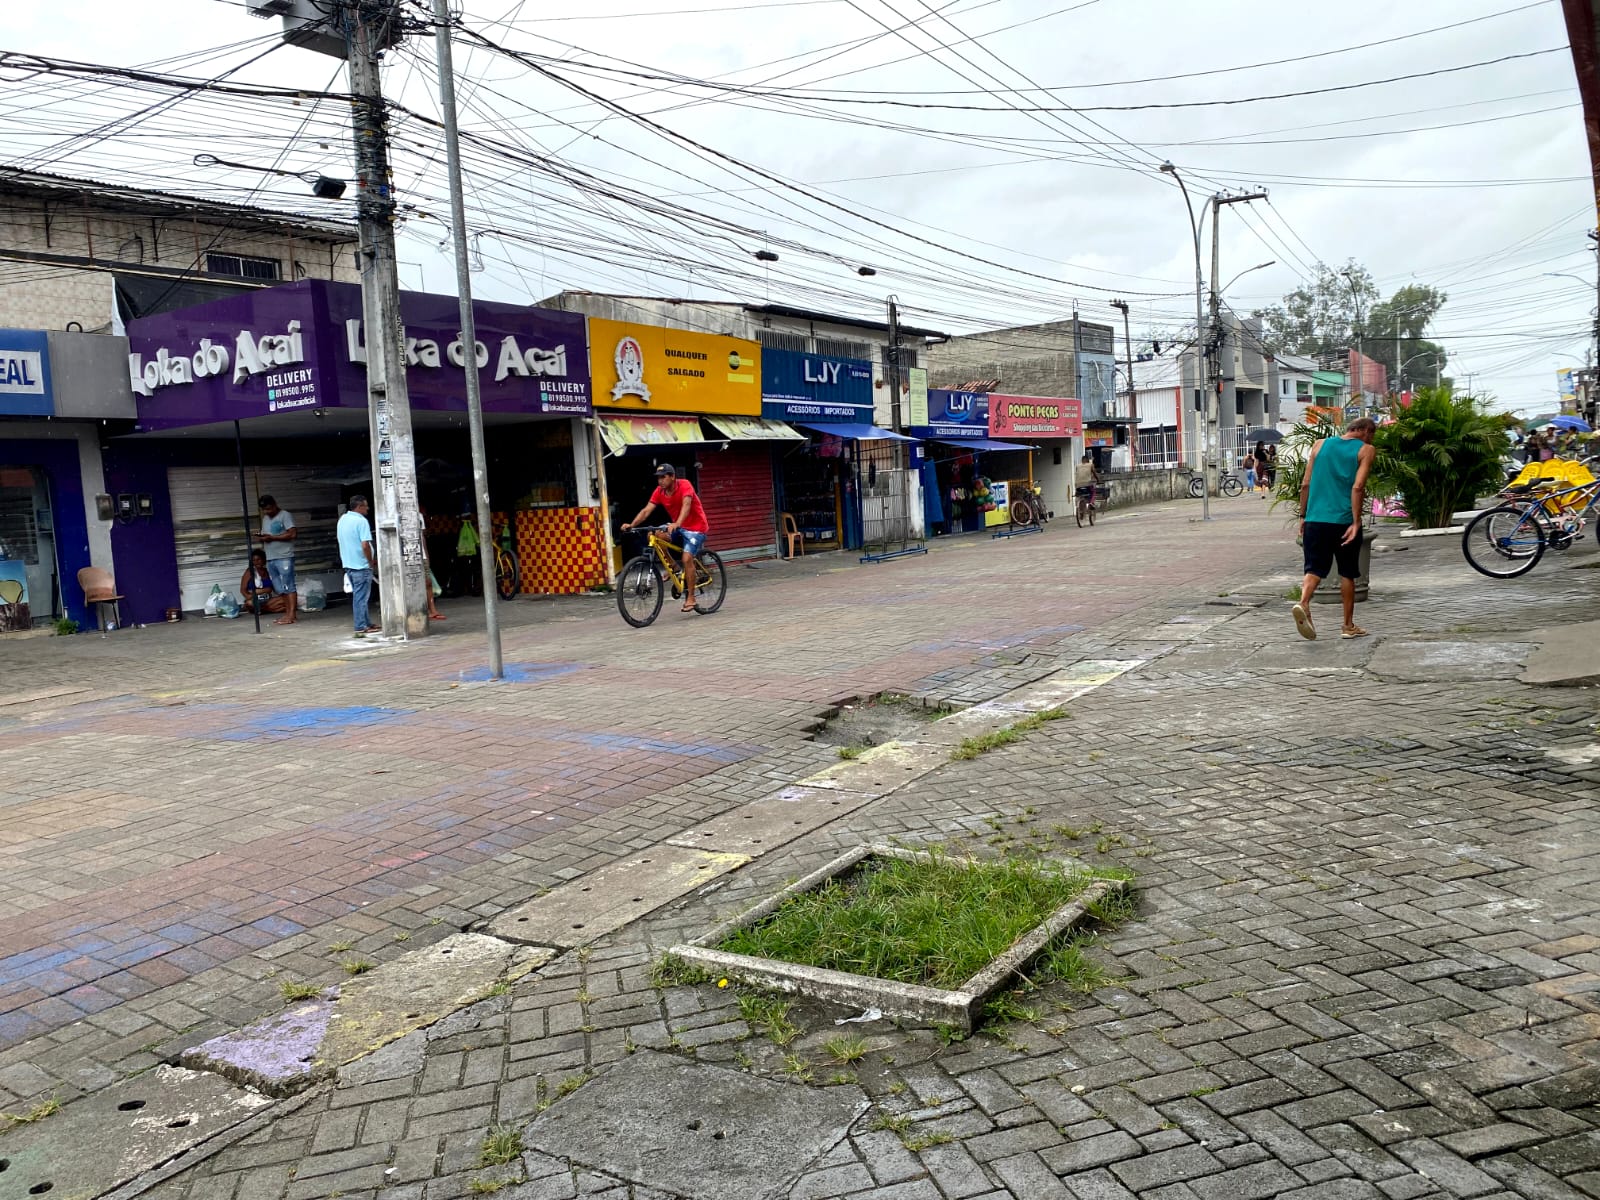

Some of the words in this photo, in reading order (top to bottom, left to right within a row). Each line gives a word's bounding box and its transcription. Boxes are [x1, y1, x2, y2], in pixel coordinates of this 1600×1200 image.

[664, 348, 708, 361] QUALQUER
[128, 347, 194, 397] Loka
[193, 338, 229, 378] do
[667, 367, 705, 378] SALGADO
[804, 359, 841, 385] LJY
[266, 368, 312, 388] DELIVERY
[540, 381, 585, 393] DELIVERY
[824, 406, 855, 416] IMPORTADOS
[950, 393, 974, 411] LJY
[1008, 402, 1035, 419] PONTE
[1036, 404, 1059, 422] PEÇAS
